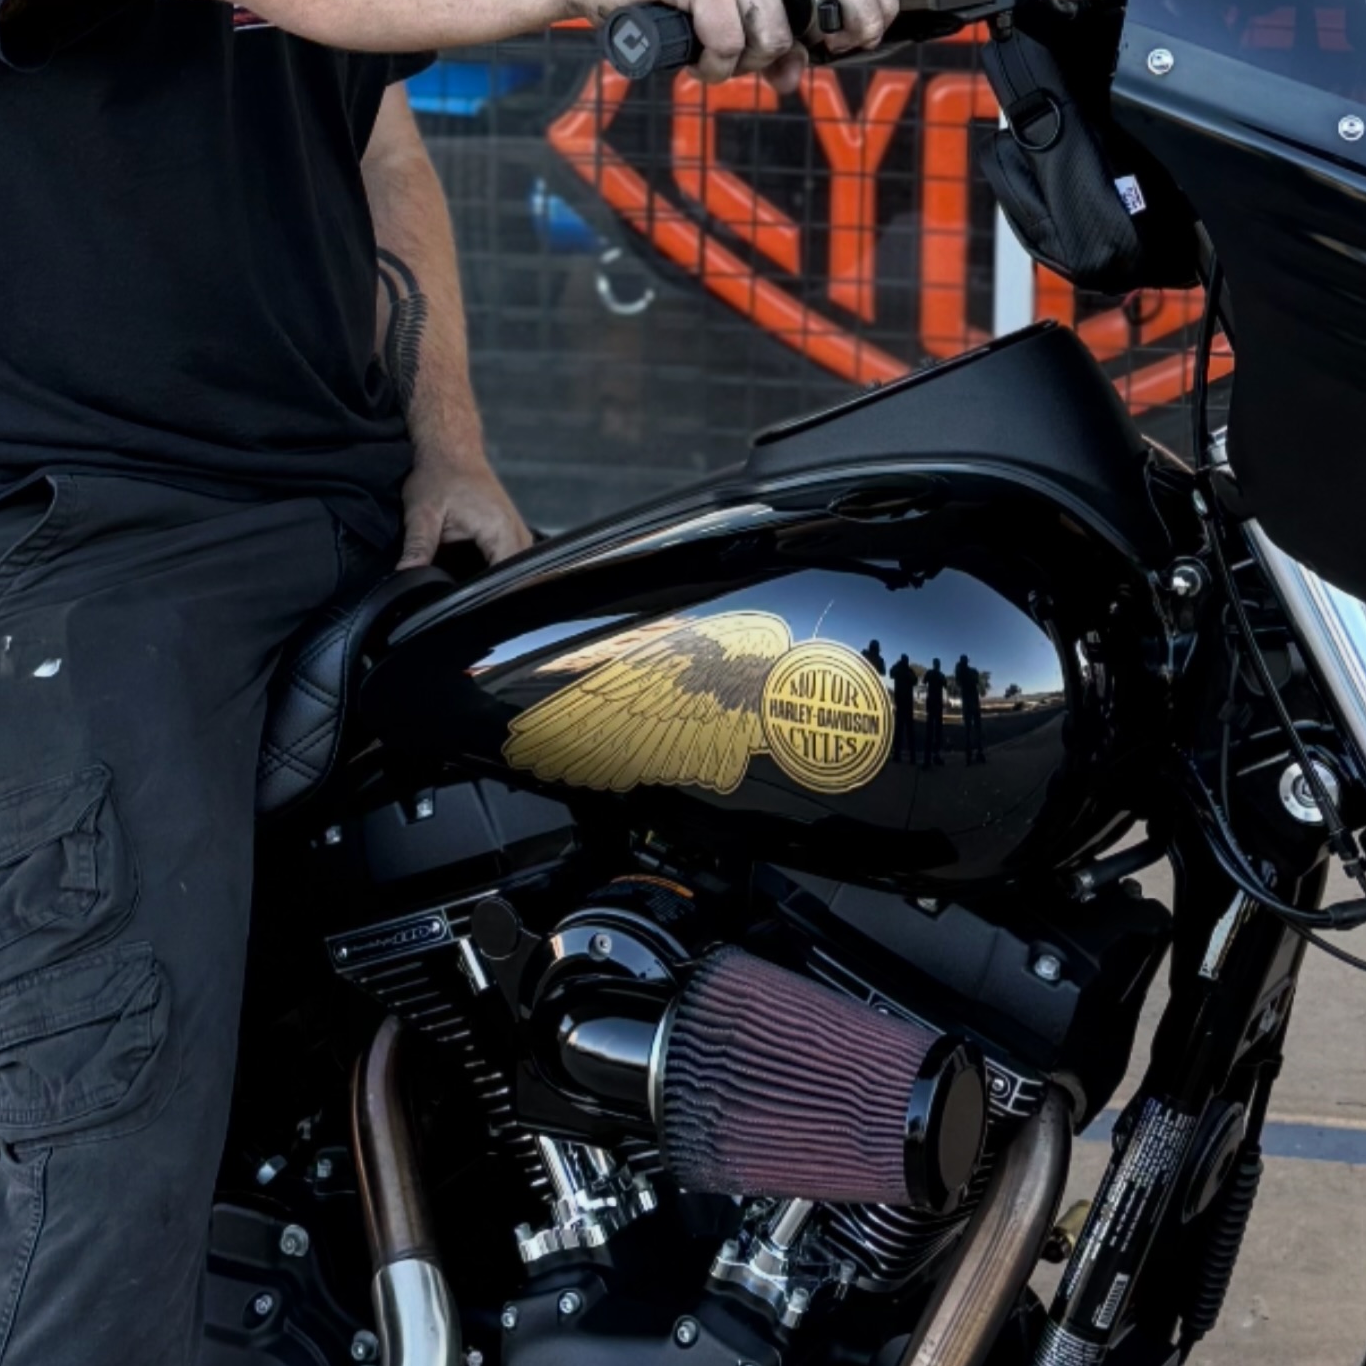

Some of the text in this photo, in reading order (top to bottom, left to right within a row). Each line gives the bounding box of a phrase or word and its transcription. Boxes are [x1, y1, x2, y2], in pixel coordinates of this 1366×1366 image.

[789, 668, 861, 709] MOTOR
[769, 698, 880, 736] HARLEY-DAVIDSON
[789, 726, 858, 764] CYCLES
